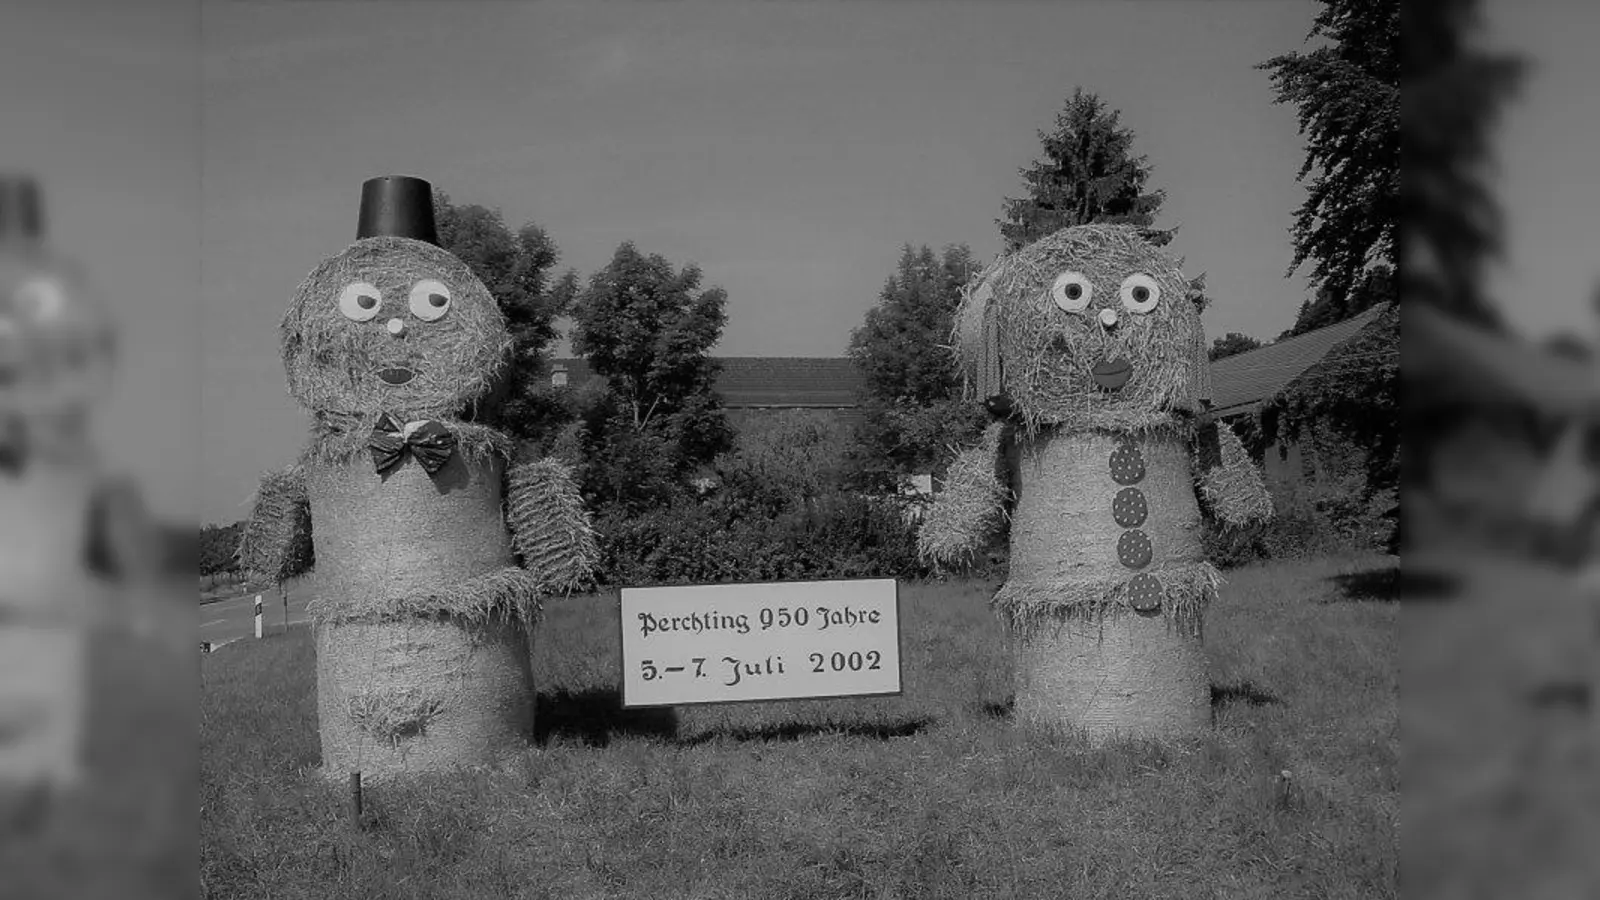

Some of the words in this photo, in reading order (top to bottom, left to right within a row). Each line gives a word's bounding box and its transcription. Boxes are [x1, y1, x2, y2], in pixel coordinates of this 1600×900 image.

[637, 610, 751, 639] Perchting
[759, 606, 809, 631] 950
[815, 606, 881, 631] Jahre
[721, 656, 785, 687] Juli
[809, 650, 881, 673] 2002
